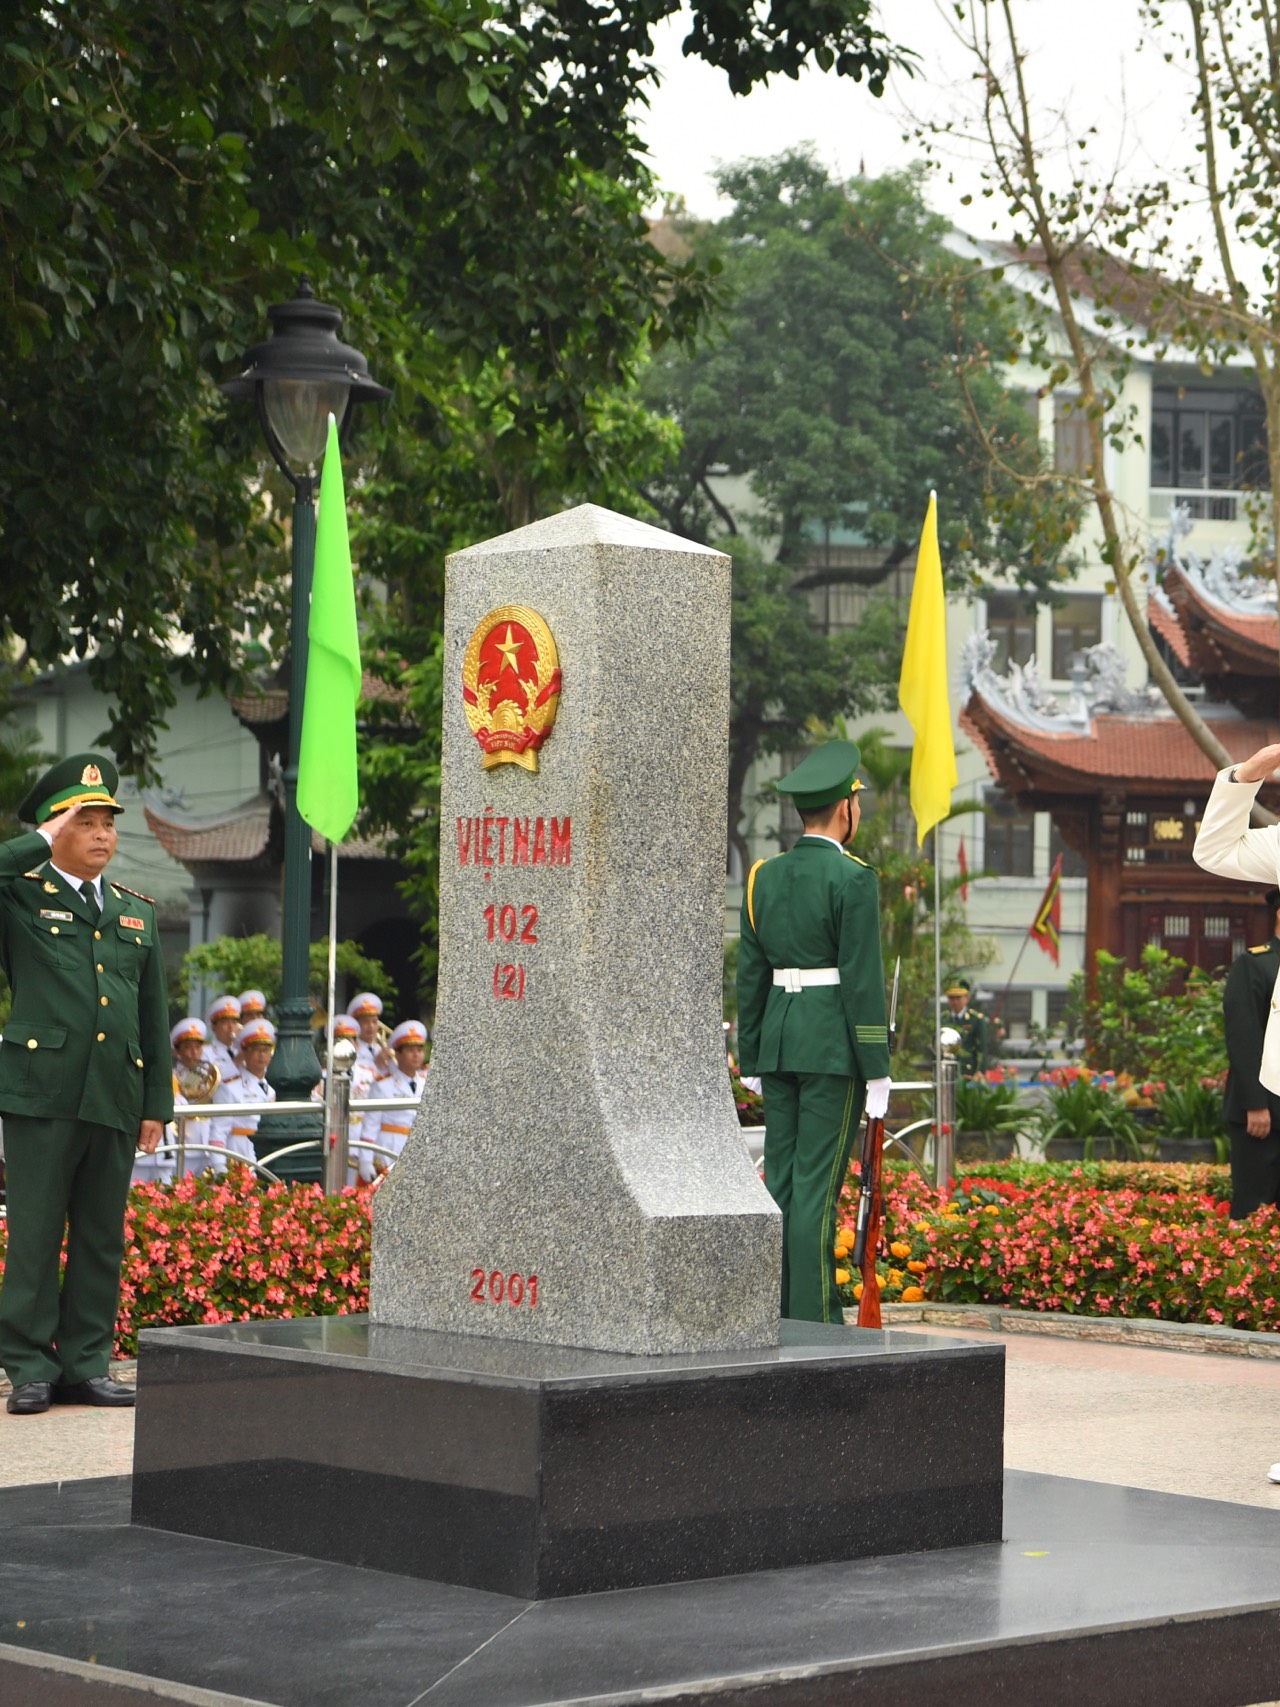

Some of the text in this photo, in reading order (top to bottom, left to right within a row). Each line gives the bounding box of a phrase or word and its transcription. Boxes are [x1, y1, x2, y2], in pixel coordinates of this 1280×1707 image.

[483, 903, 539, 944] 102
[493, 963, 525, 1002] (2)
[470, 1268, 538, 1309] 2001
